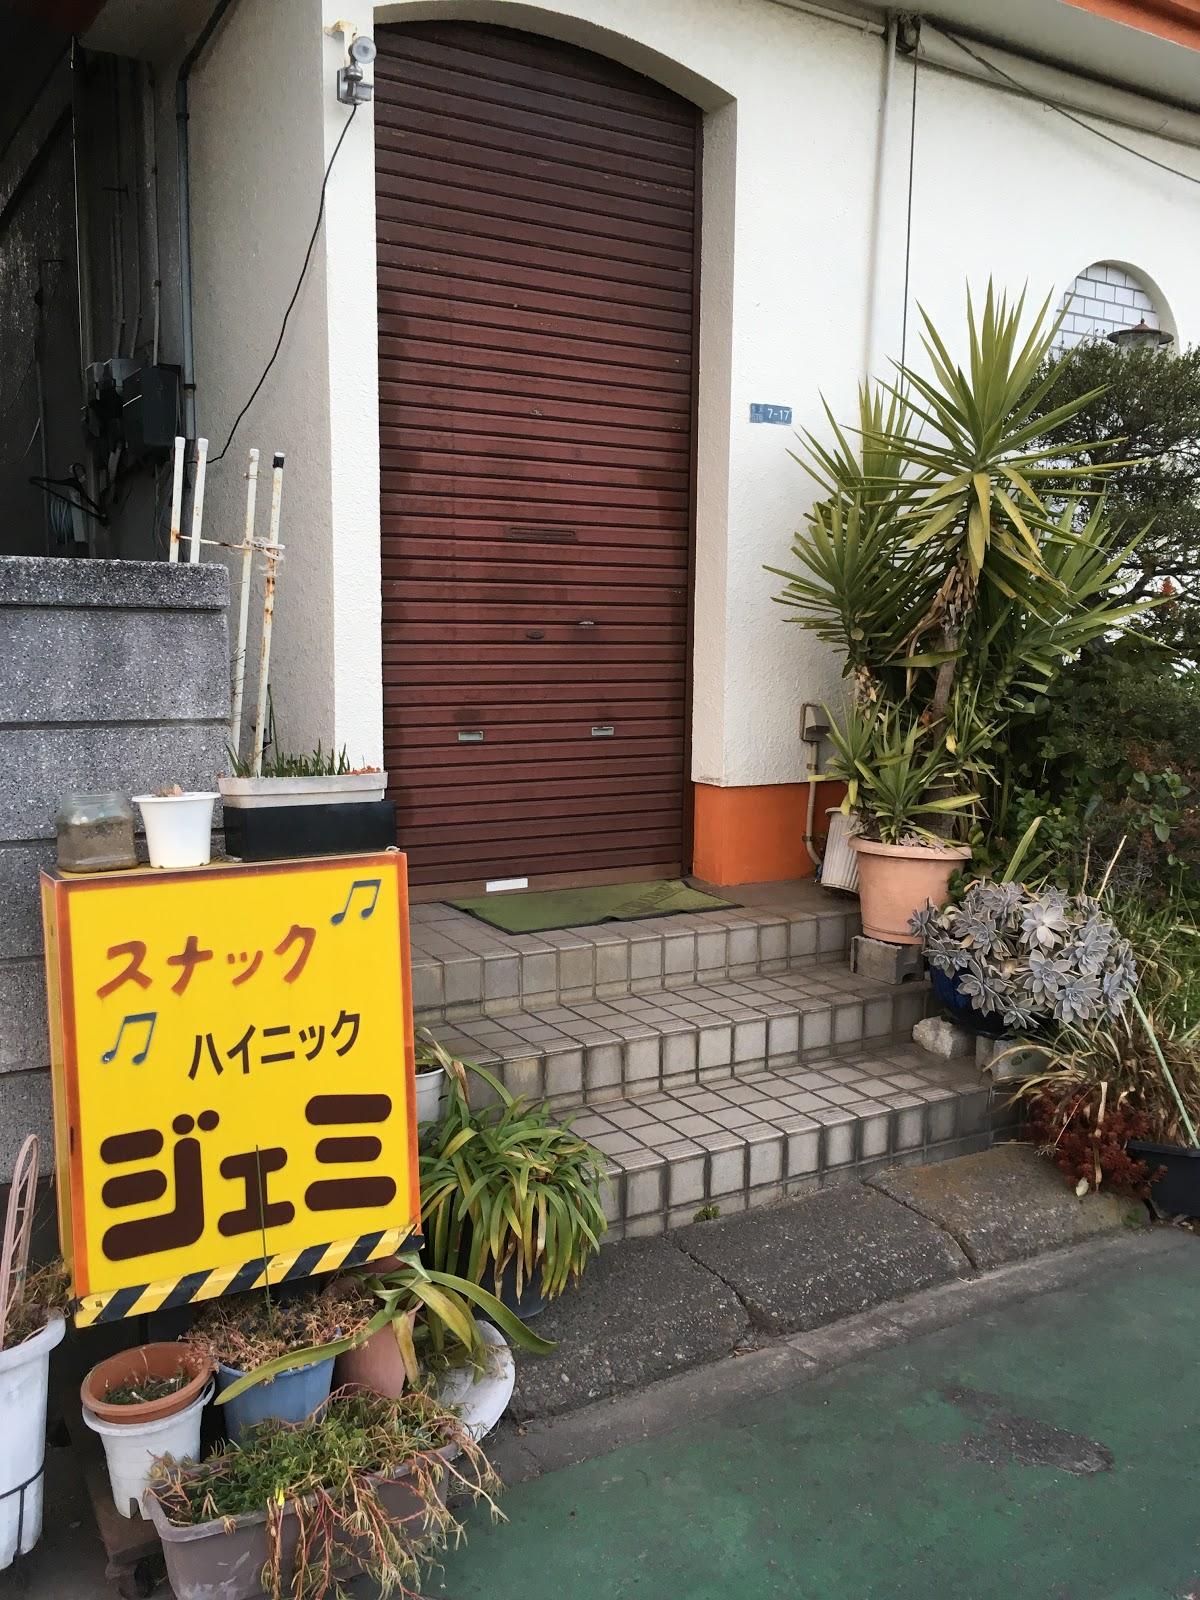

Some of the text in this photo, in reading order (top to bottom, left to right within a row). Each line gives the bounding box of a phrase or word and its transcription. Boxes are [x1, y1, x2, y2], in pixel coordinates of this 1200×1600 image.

[767, 407, 790, 421] 7-17
[97, 924, 317, 998] スナック
[188, 1010, 360, 1080] ハイニック
[100, 1094, 397, 1261] ジェミ
